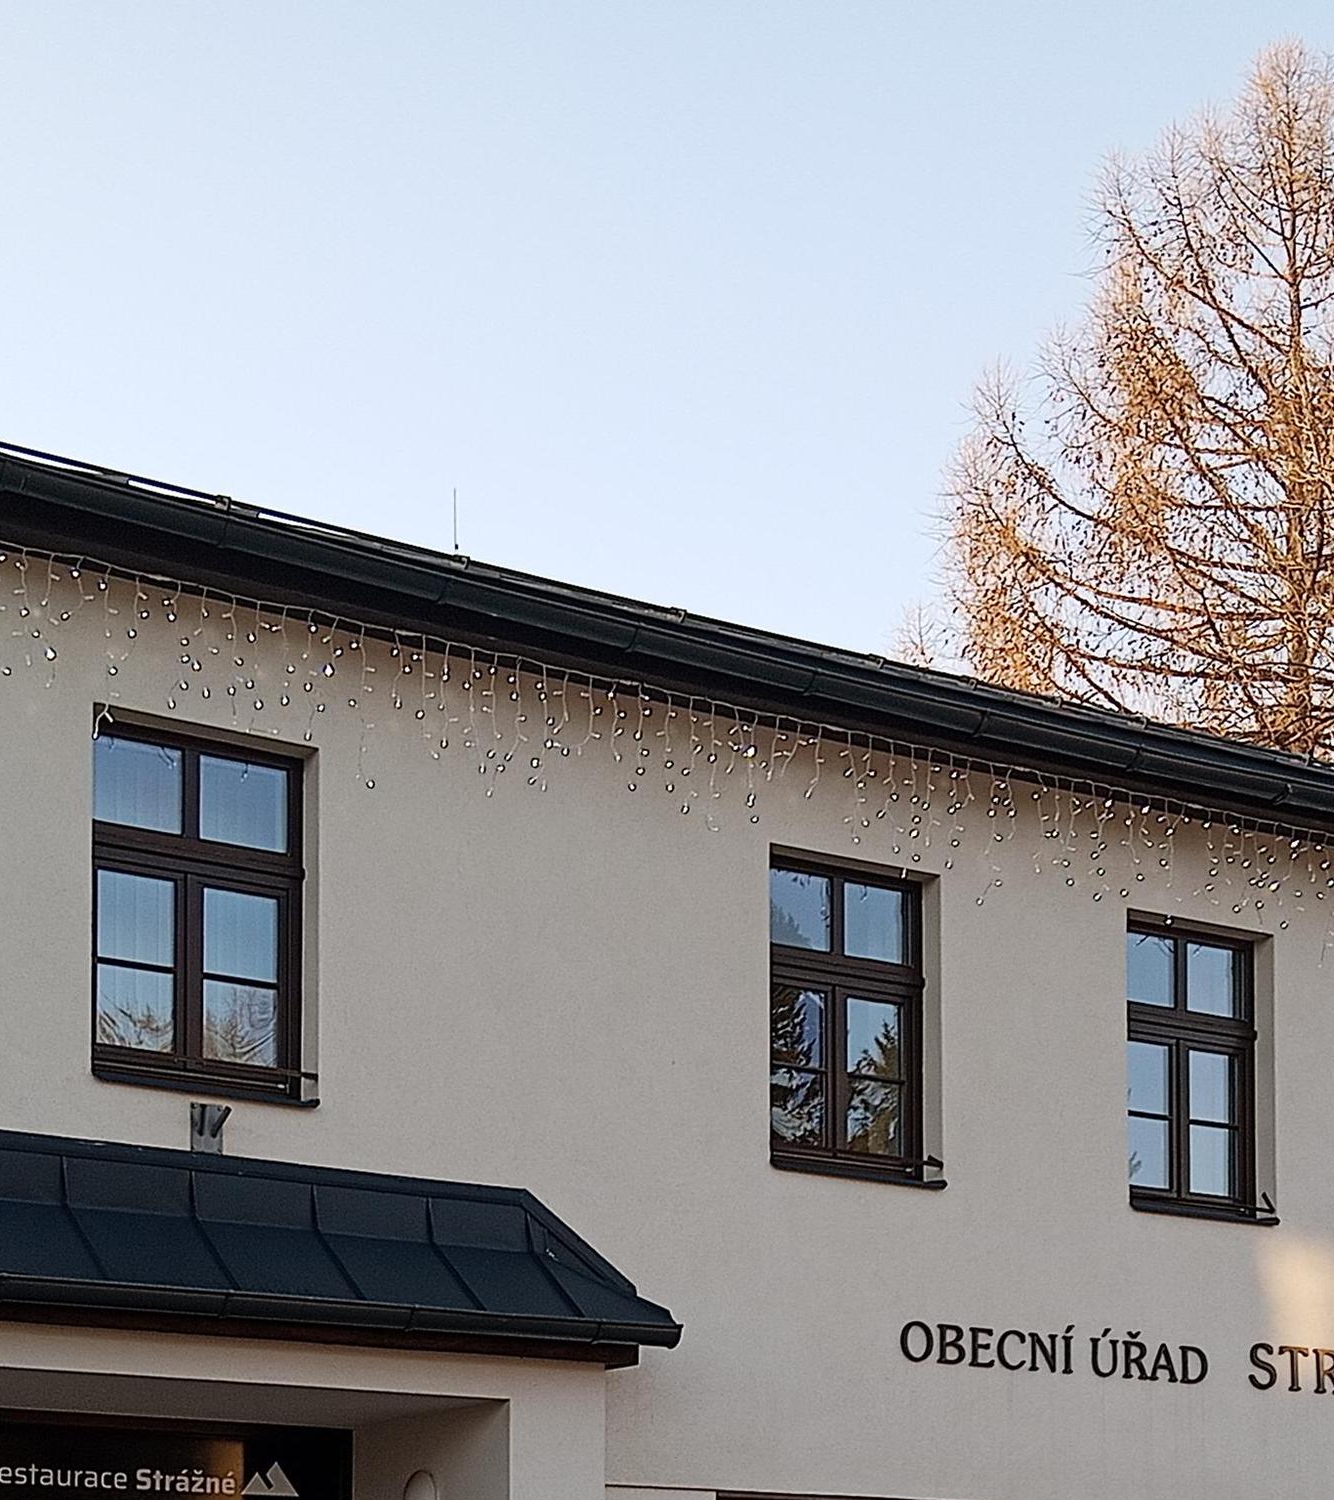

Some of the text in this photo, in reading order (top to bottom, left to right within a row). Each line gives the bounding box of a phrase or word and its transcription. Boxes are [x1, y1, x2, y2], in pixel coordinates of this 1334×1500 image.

[899, 1320, 1075, 1375] OBECNÍ
[1089, 1327, 1208, 1385] ÚŘAD
[136, 1467, 236, 1496] Strážné
